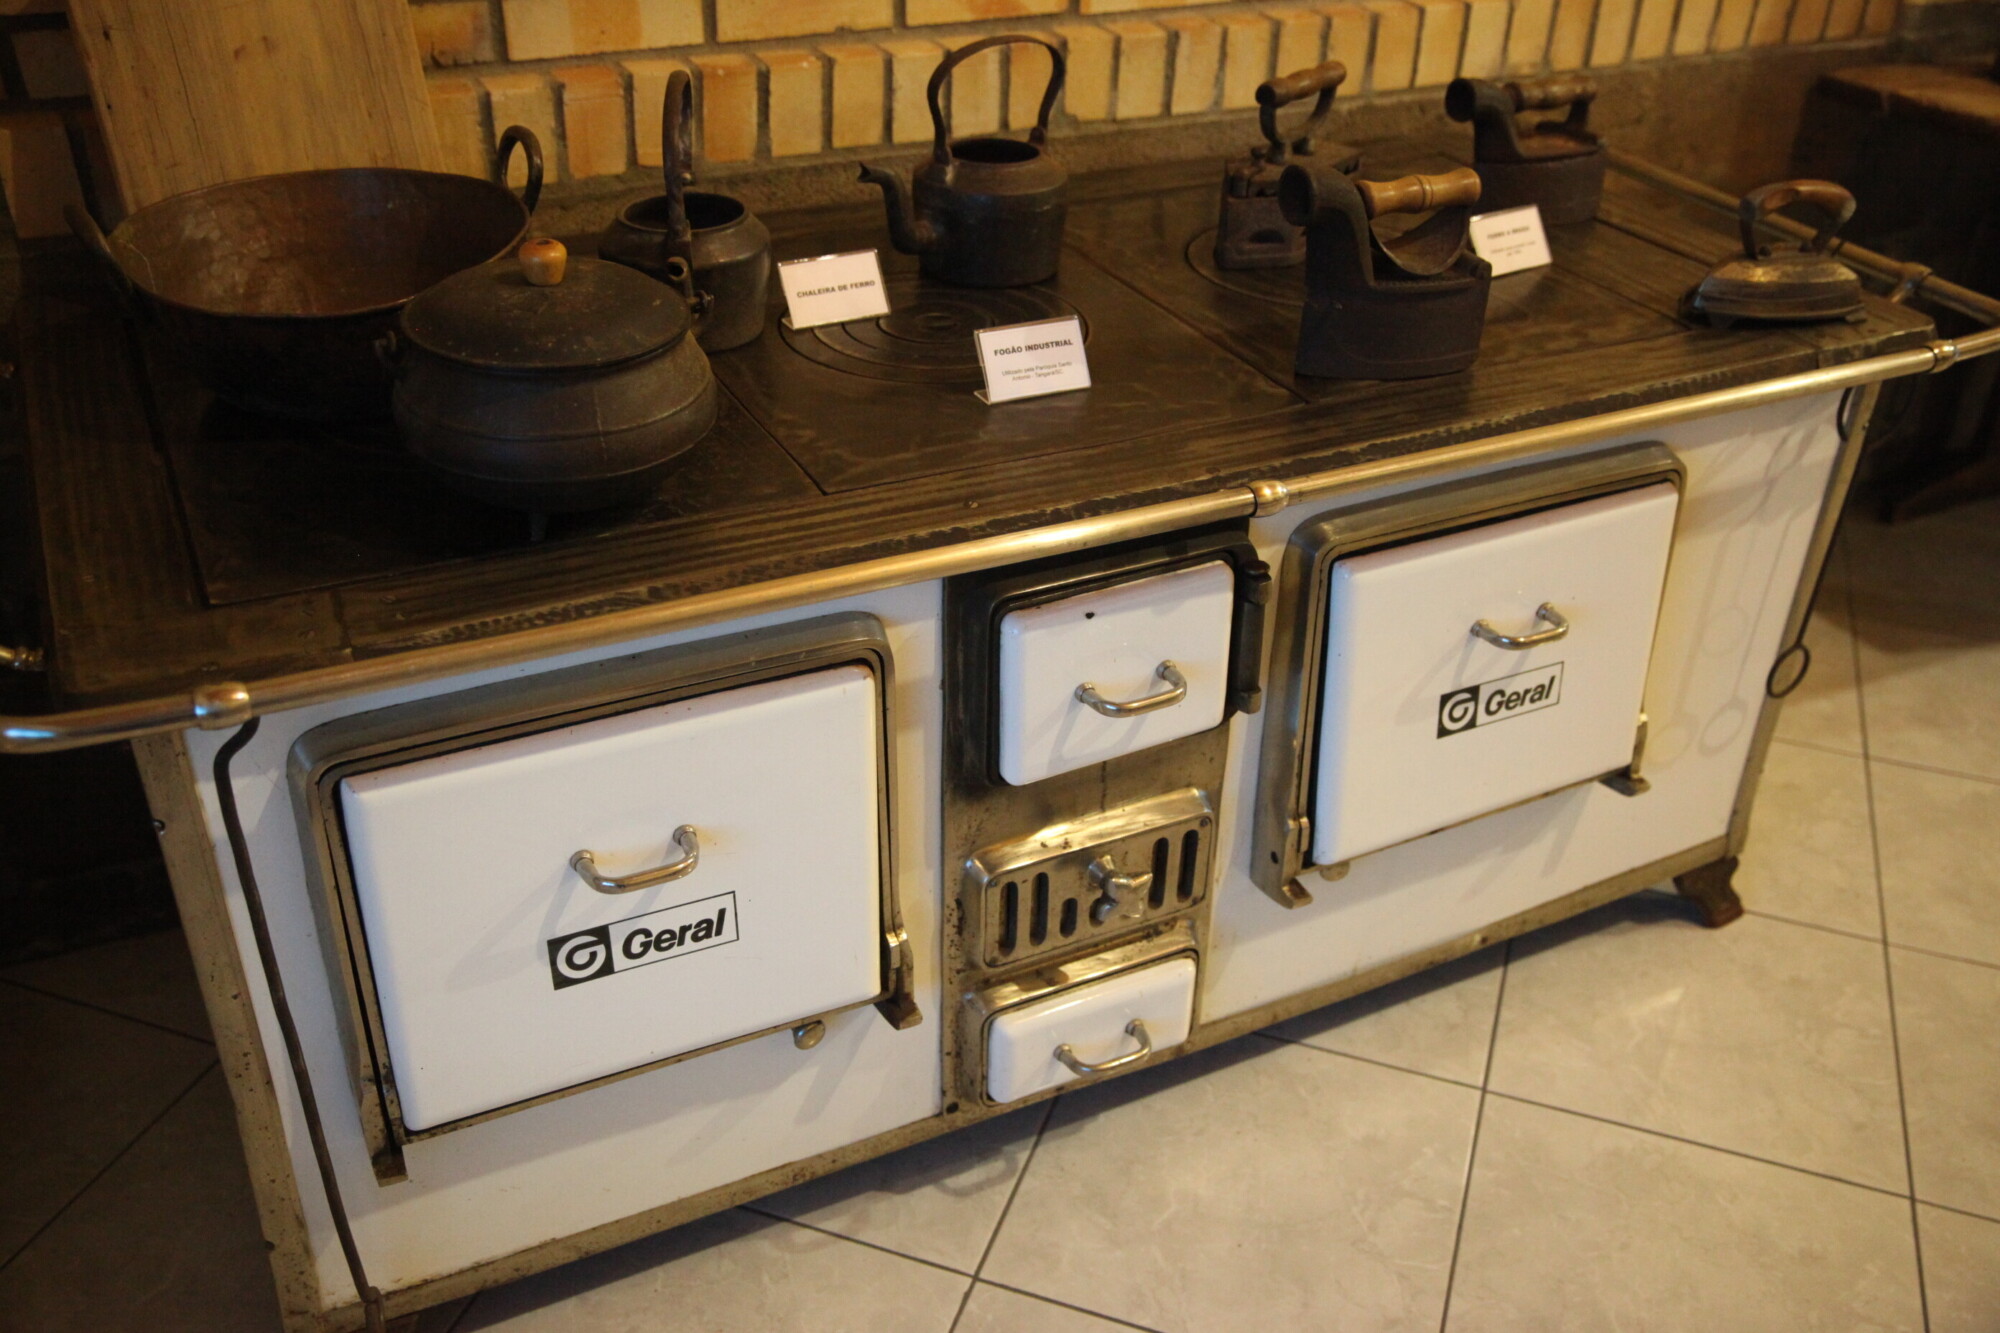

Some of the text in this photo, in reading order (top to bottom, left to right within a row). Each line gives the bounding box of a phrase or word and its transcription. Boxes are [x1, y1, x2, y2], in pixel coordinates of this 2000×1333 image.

[796, 280, 876, 298] CHALEIRA DE FERRO
[993, 339, 1074, 357] FOGÃO INDUSTRIAL
[1484, 675, 1556, 717] Geral
[622, 907, 727, 960] Geral
